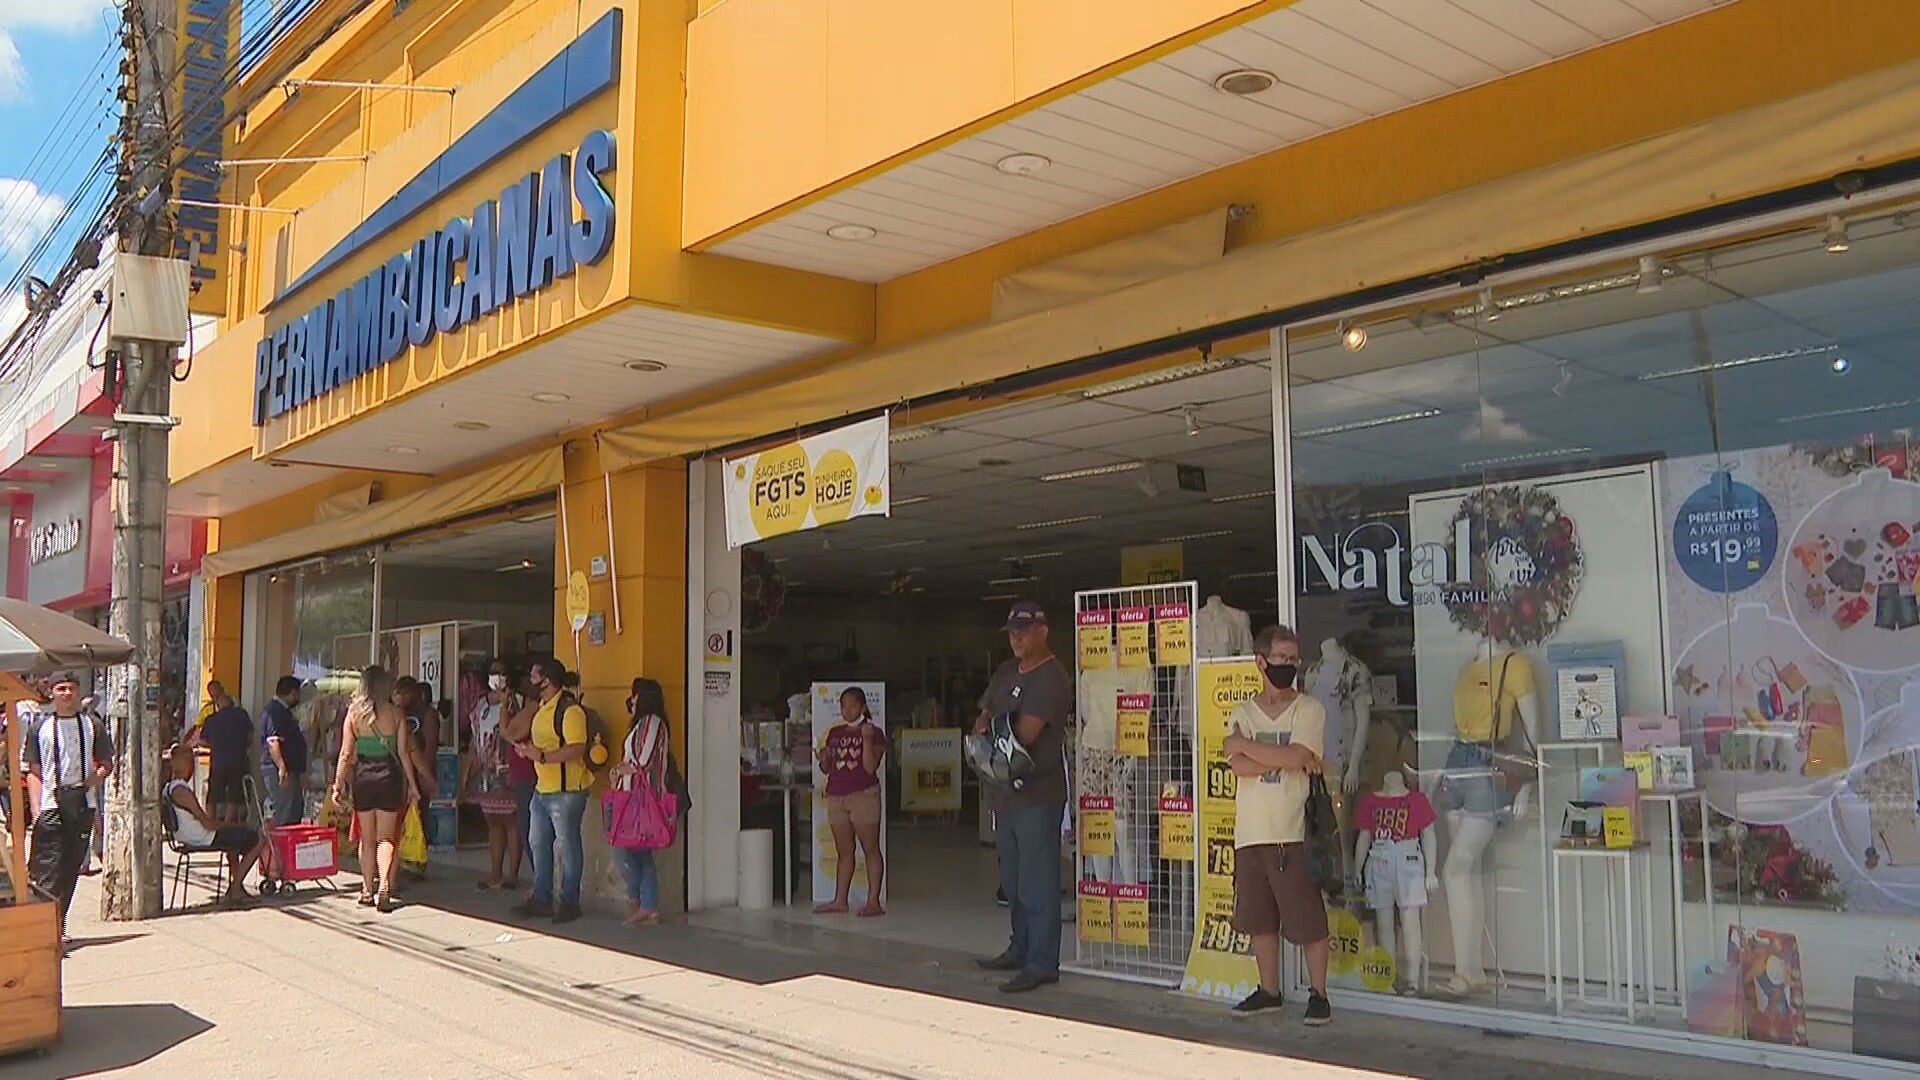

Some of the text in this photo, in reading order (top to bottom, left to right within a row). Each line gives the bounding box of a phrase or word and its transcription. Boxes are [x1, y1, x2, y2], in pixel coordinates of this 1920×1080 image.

[252, 129, 617, 426] PERNAMBUCANAS
[755, 456, 805, 480] SAQUE SEU
[815, 468, 852, 486] DINHEIRO
[755, 471, 806, 506] FGTS
[815, 479, 852, 504] HOJE
[1688, 508, 1759, 523] PRESENTES
[1689, 522, 1760, 536] A PARTIR DE
[1302, 519, 1473, 606] Natal
[1082, 614, 1105, 624] oferta
[1121, 611, 1144, 621] oferta
[1160, 607, 1183, 617] oferta
[1122, 698, 1144, 707] oferta
[1211, 767, 1236, 797] 99
[1085, 799, 1109, 809] oferta
[1164, 800, 1188, 809] oferta
[1213, 845, 1235, 875] 79
[1084, 884, 1106, 895] oferta
[1119, 887, 1143, 896] oferta
[1328, 936, 1359, 953] GTS
[1363, 964, 1392, 976] HOJE
